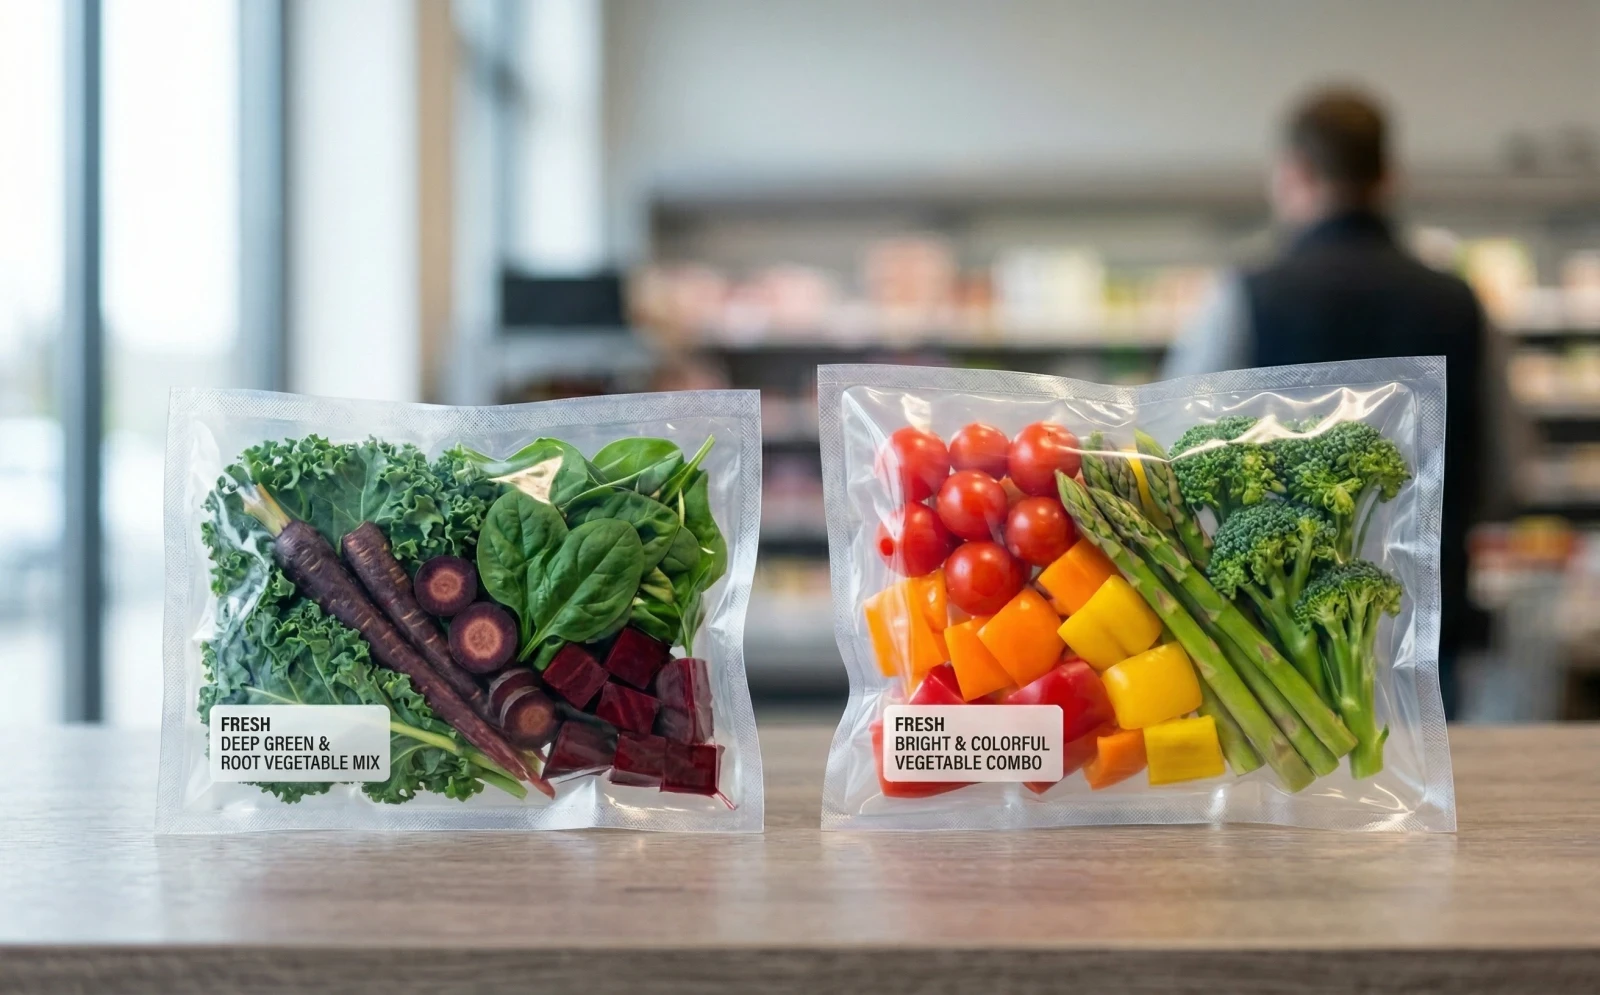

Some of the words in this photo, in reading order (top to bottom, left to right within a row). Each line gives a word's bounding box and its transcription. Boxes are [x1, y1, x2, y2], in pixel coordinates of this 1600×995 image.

[221, 716, 271, 732] FRESH
[895, 716, 945, 732] FRESH
[221, 735, 260, 752] DEEP
[264, 735, 314, 752] GREEN
[318, 735, 330, 752] &
[895, 735, 952, 752] BRIGHT
[954, 735, 967, 752] &
[971, 735, 1051, 752] COLORFUL
[221, 754, 261, 771] ROOT
[263, 754, 349, 771] VEGETABLE
[352, 754, 380, 771] MIX
[894, 754, 982, 771] VEGETABLE
[986, 754, 1042, 771] COMBO
